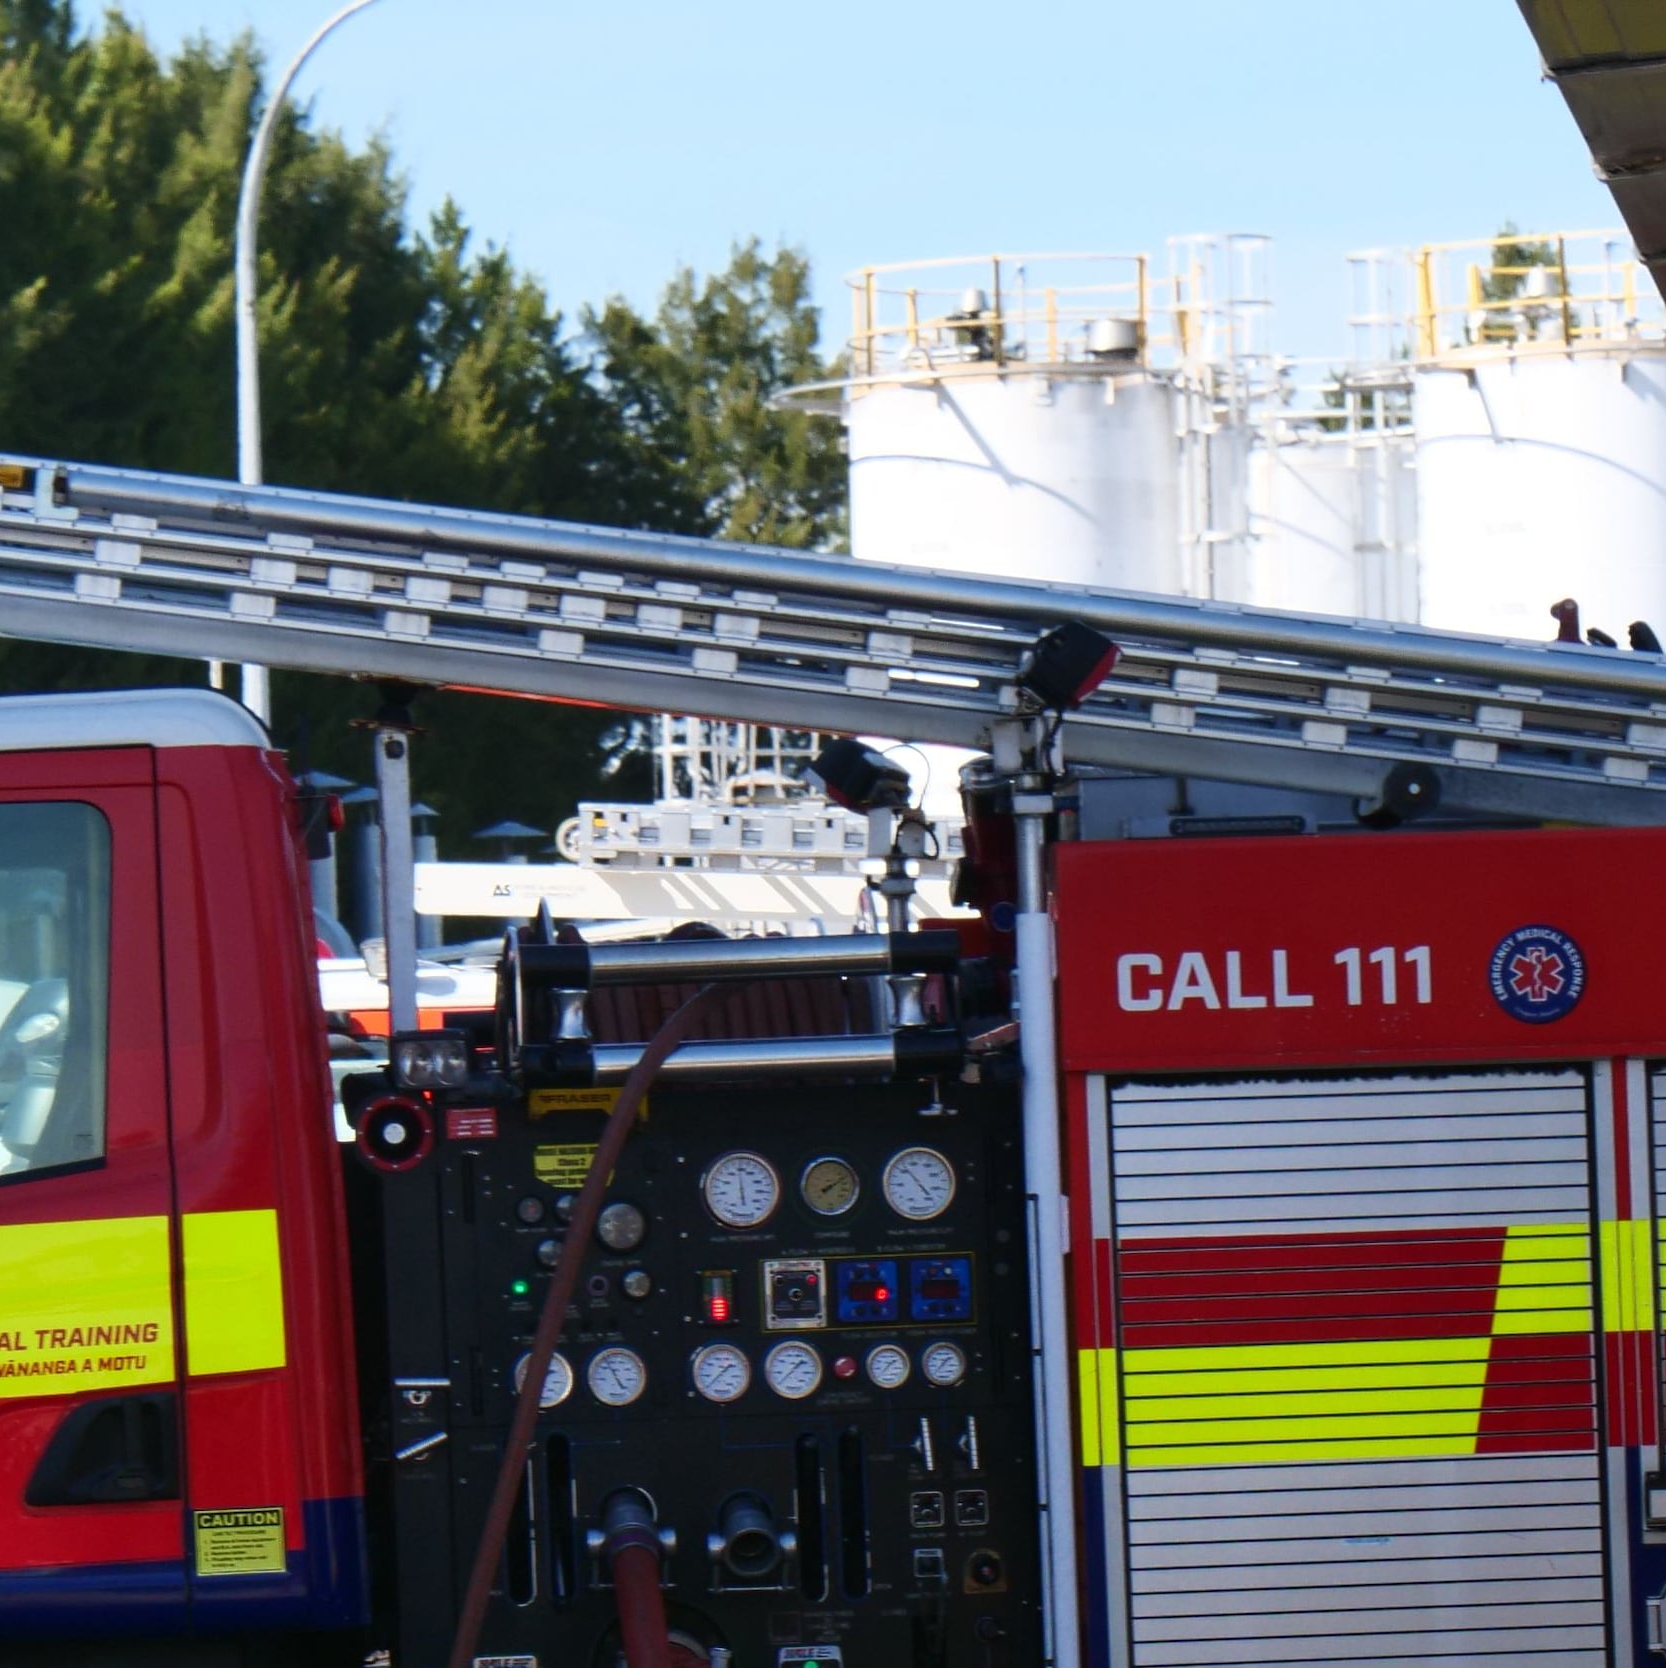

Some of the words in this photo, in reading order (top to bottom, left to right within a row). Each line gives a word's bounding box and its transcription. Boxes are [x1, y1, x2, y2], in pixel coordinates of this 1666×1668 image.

[1491, 938, 1515, 1001] EMERGENCY
[1515, 928, 1563, 944] MEDICAL
[1563, 942, 1583, 998] RESPONSE
[1117, 949, 1314, 1012] CALL
[1334, 946, 1432, 1006] 111
[541, 1093, 611, 1104] FRASER
[35, 1323, 159, 1349] TRAINING
[81, 1360, 93, 1373] A
[98, 1355, 147, 1372] MOTU
[199, 1512, 278, 1528] CAUTION
